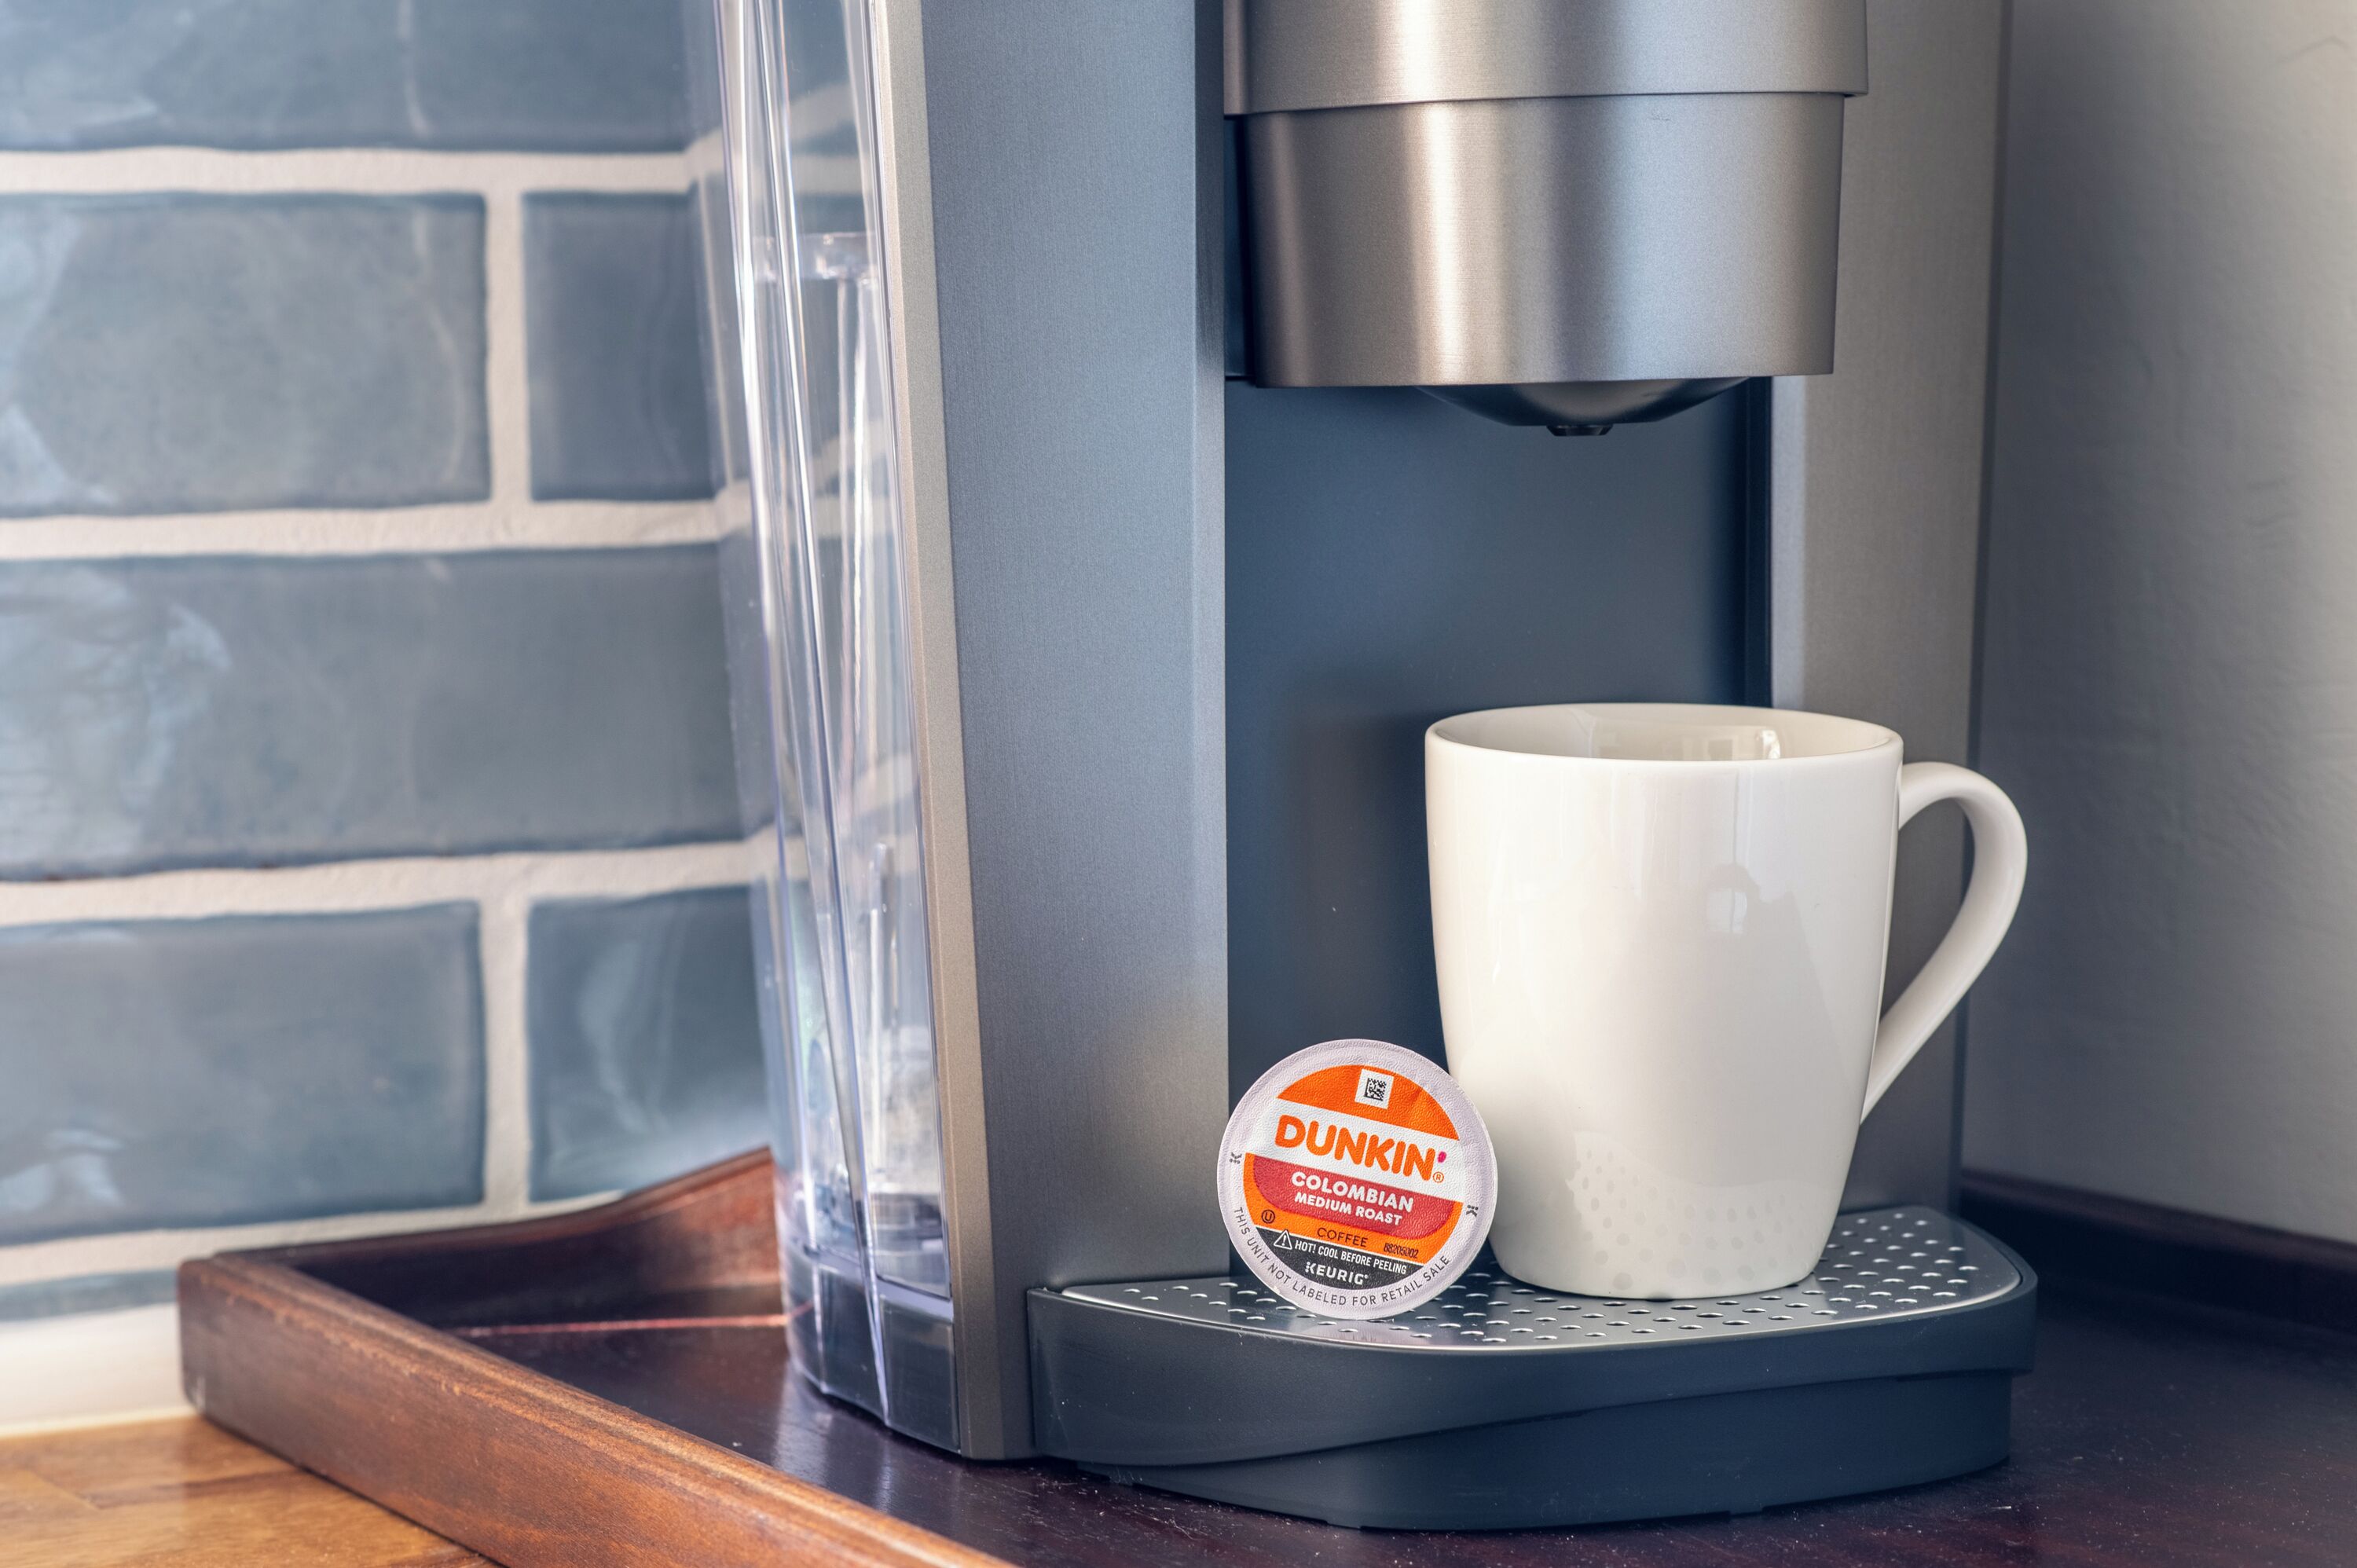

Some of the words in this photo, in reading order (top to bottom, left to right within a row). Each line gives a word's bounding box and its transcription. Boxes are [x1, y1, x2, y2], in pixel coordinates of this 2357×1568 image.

[1292, 1171, 1413, 1213] COLOMBIAN
[1295, 1192, 1351, 1214] MEDIUM
[1355, 1205, 1402, 1225] ROAST
[1317, 1228, 1368, 1247] COFFEE
[1234, 1207, 1250, 1235] THIS
[1247, 1237, 1270, 1263] UNIT
[1267, 1262, 1291, 1284] NOT
[1292, 1281, 1347, 1305] LABELED
[1352, 1295, 1376, 1306] FOR
[1381, 1280, 1422, 1302] RETAIL
[1423, 1255, 1450, 1281] SALE
[1295, 1240, 1316, 1254] HOT!
[1318, 1246, 1338, 1259] COOL
[1340, 1251, 1372, 1266] BEFORE
[1373, 1258, 1406, 1274] PEELING
[1304, 1261, 1365, 1285] KEURIG
